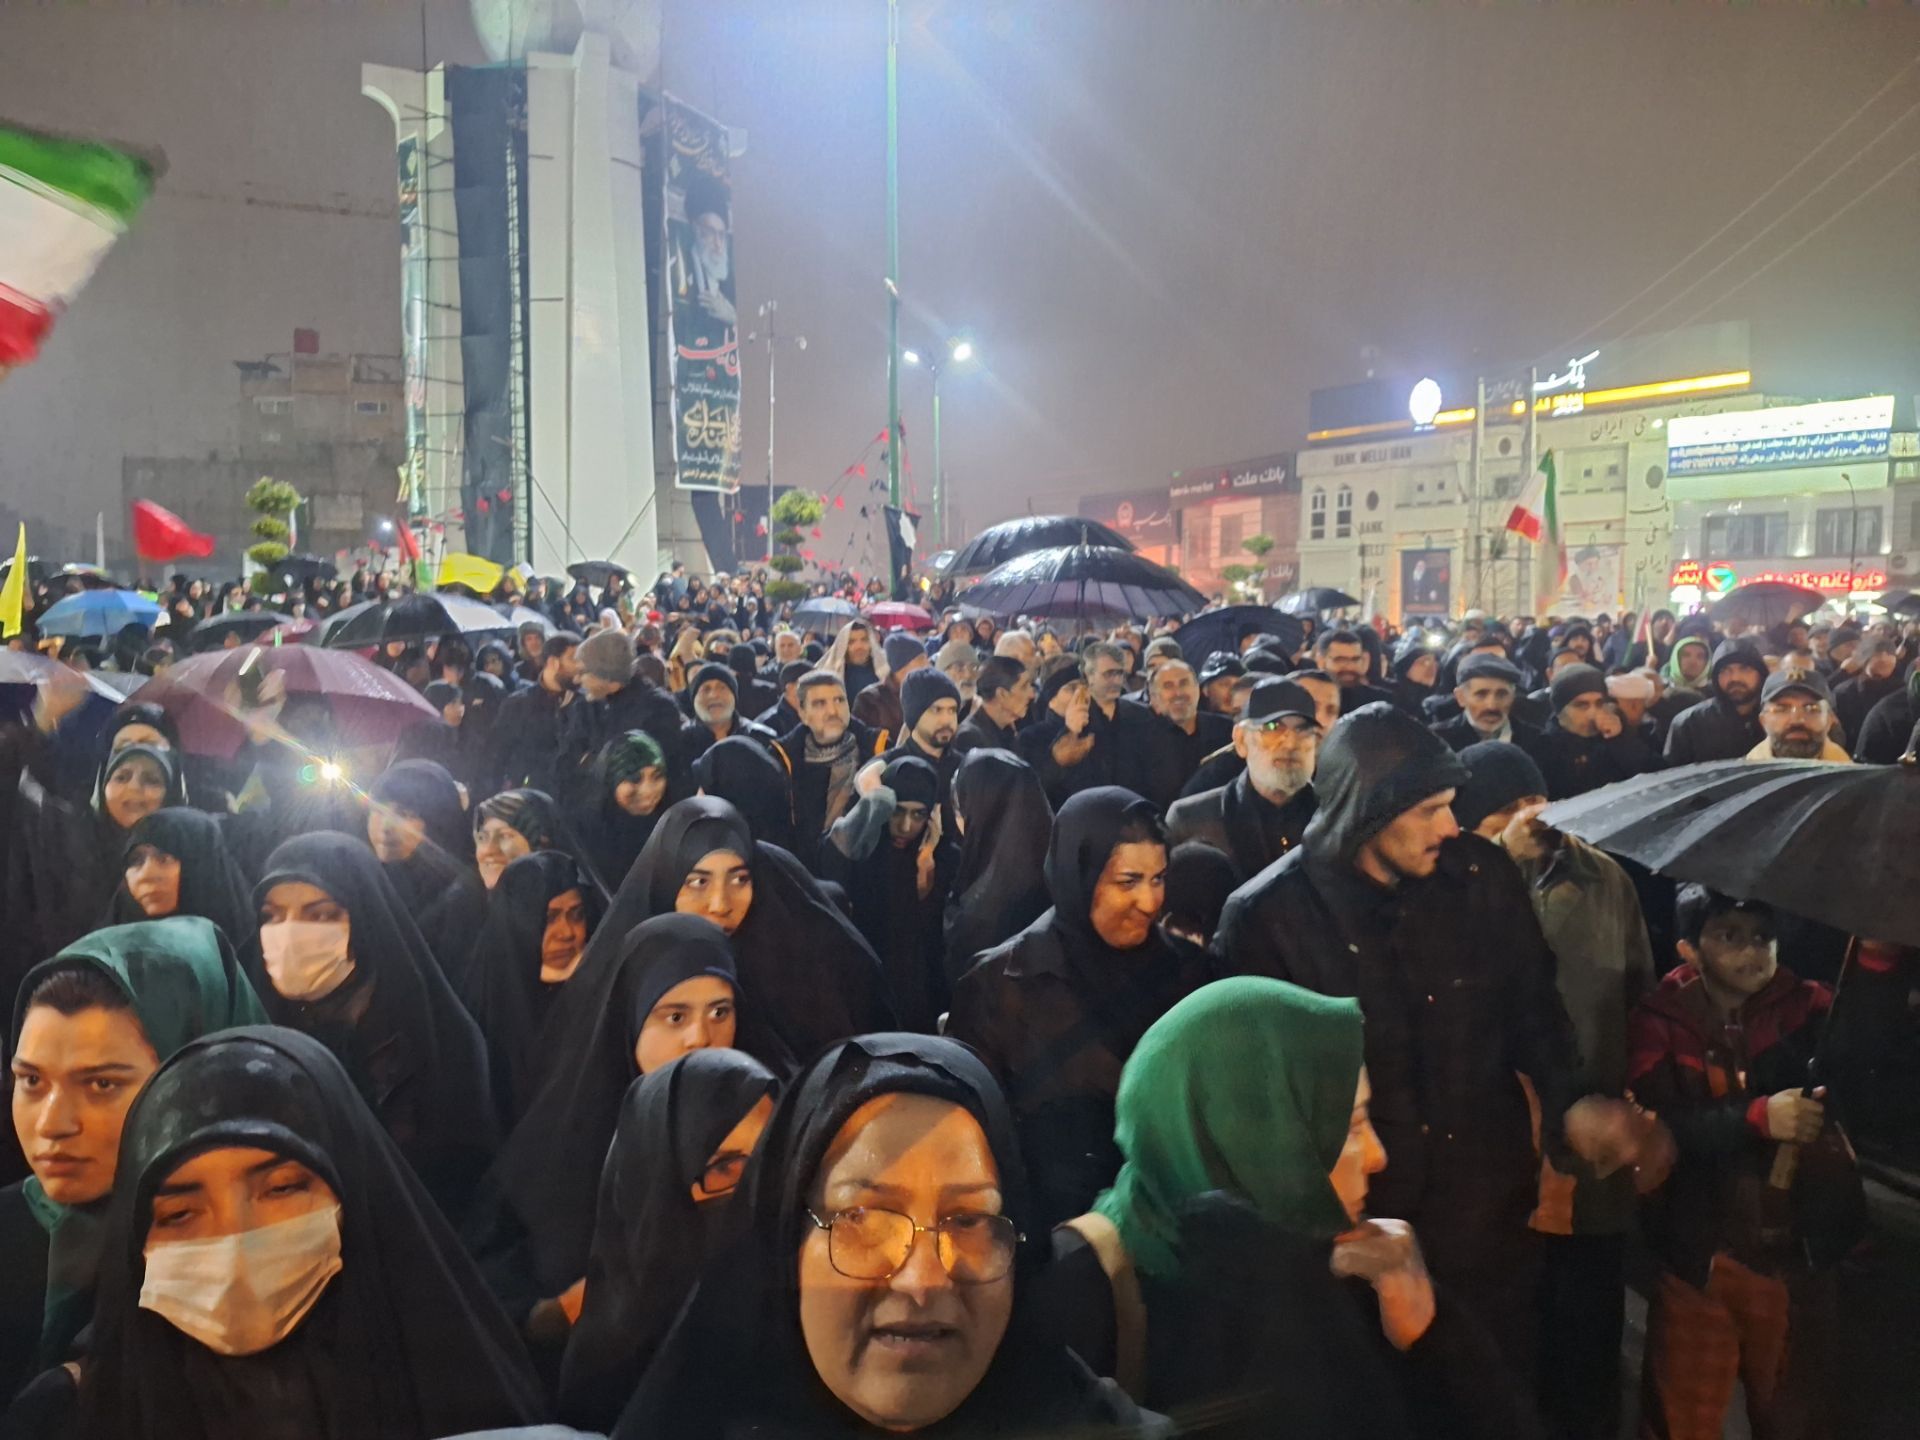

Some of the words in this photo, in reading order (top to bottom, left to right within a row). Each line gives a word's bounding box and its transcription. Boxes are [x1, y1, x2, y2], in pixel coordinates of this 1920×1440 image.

[1334, 453, 1356, 467] BANK
[1233, 472, 1258, 487] ملت
[1260, 466, 1286, 484] بانک
